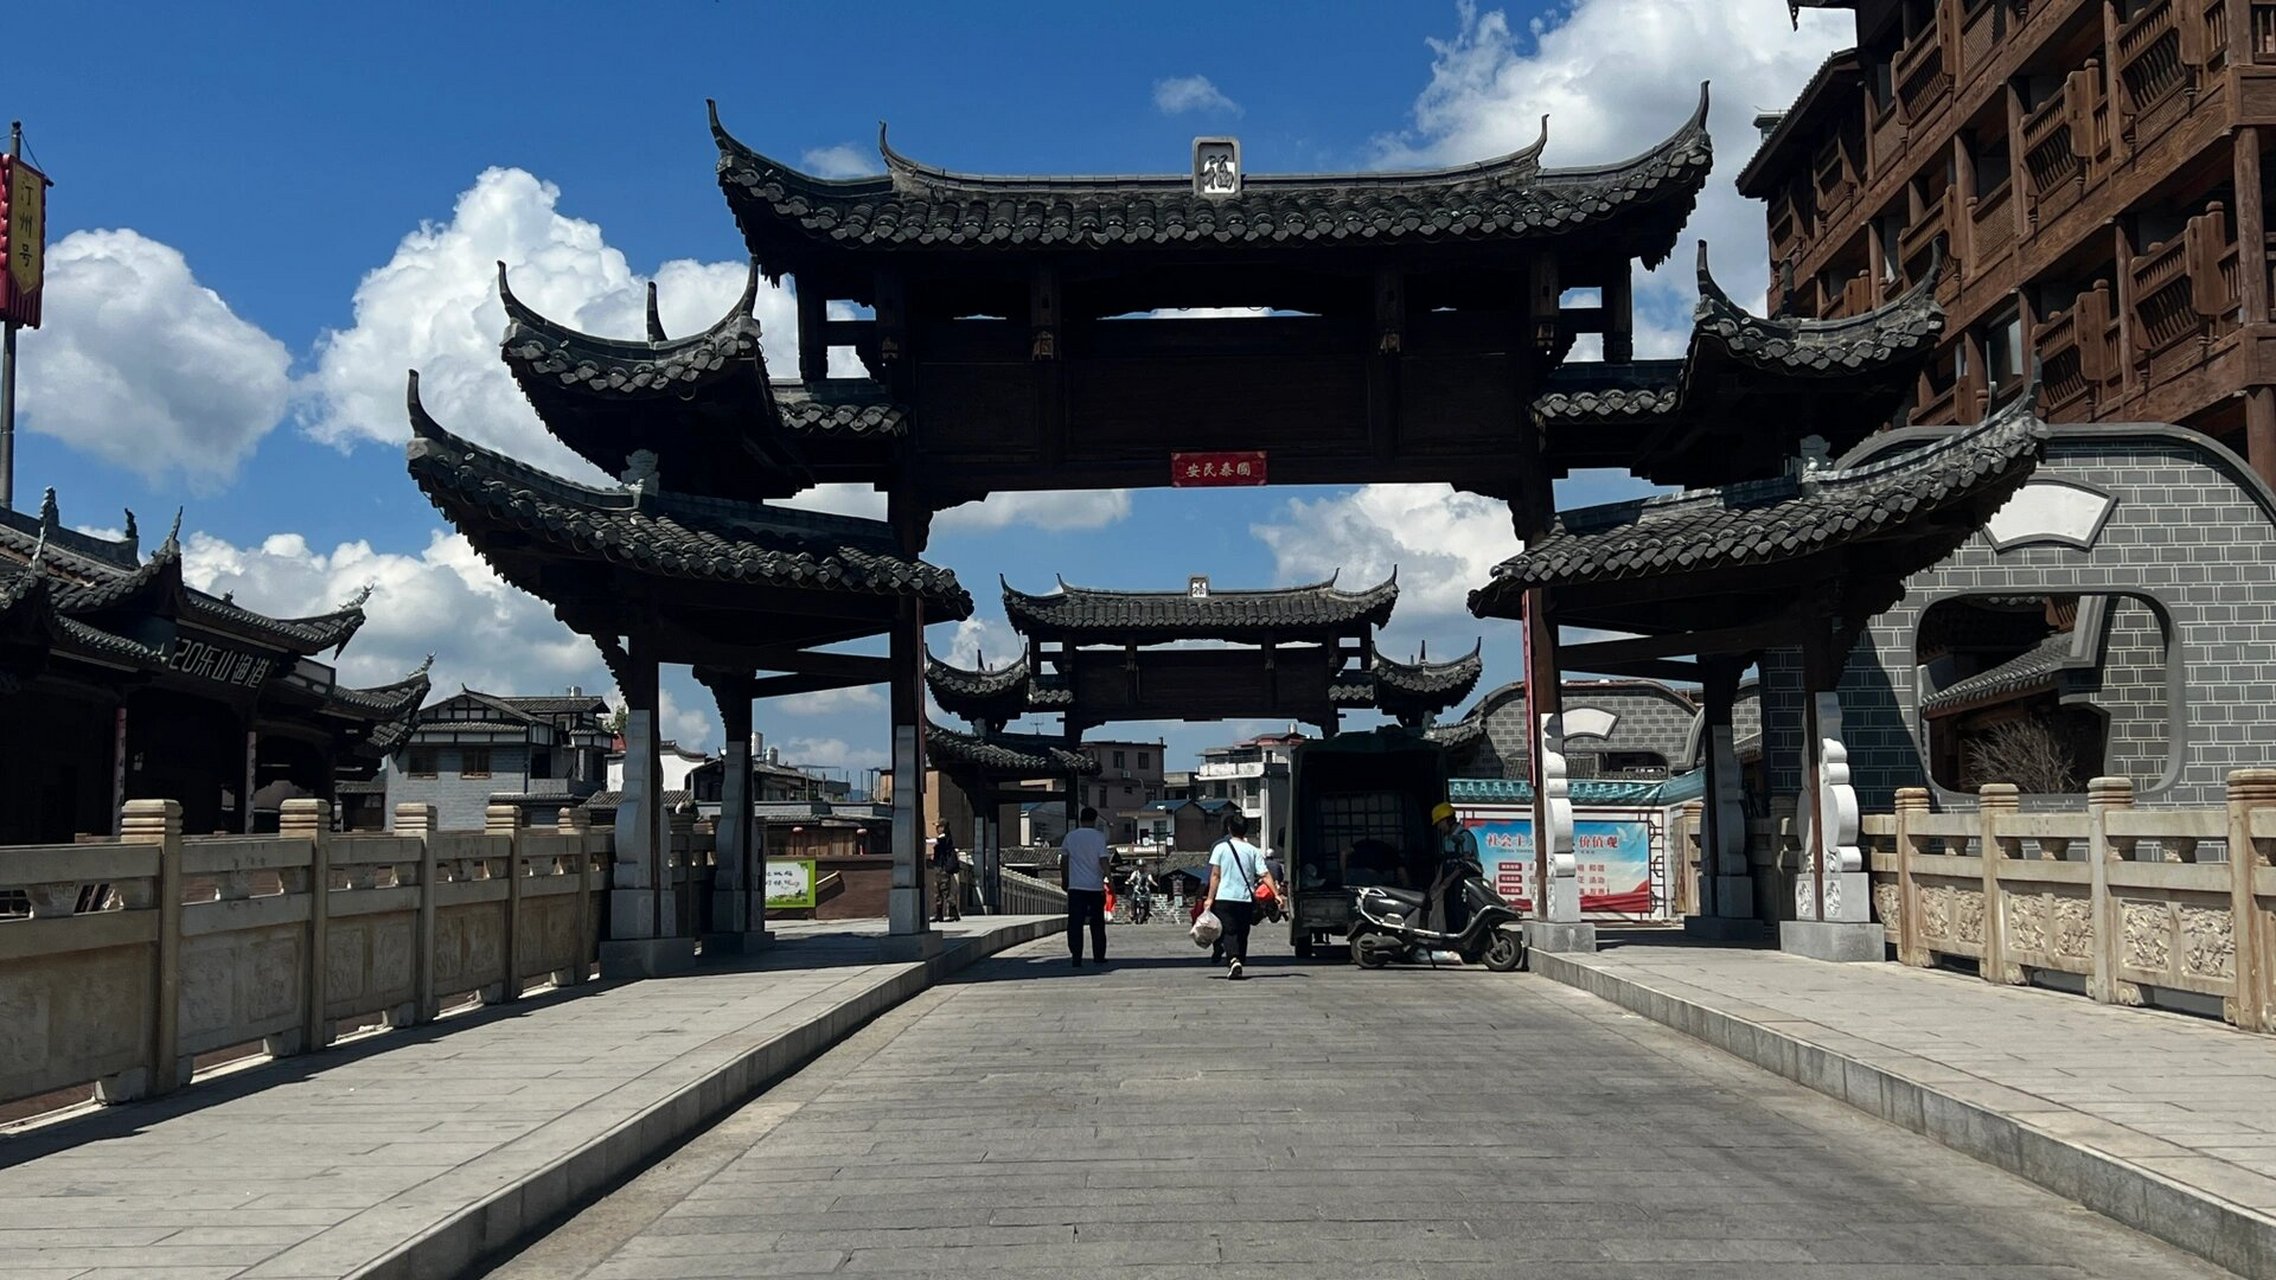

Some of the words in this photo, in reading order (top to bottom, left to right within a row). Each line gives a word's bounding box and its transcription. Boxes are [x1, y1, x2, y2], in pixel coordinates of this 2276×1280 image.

[1200, 154, 1235, 190] 福
[19, 181, 33, 268] 汀州号
[168, 636, 270, 689] 20东山渔港
